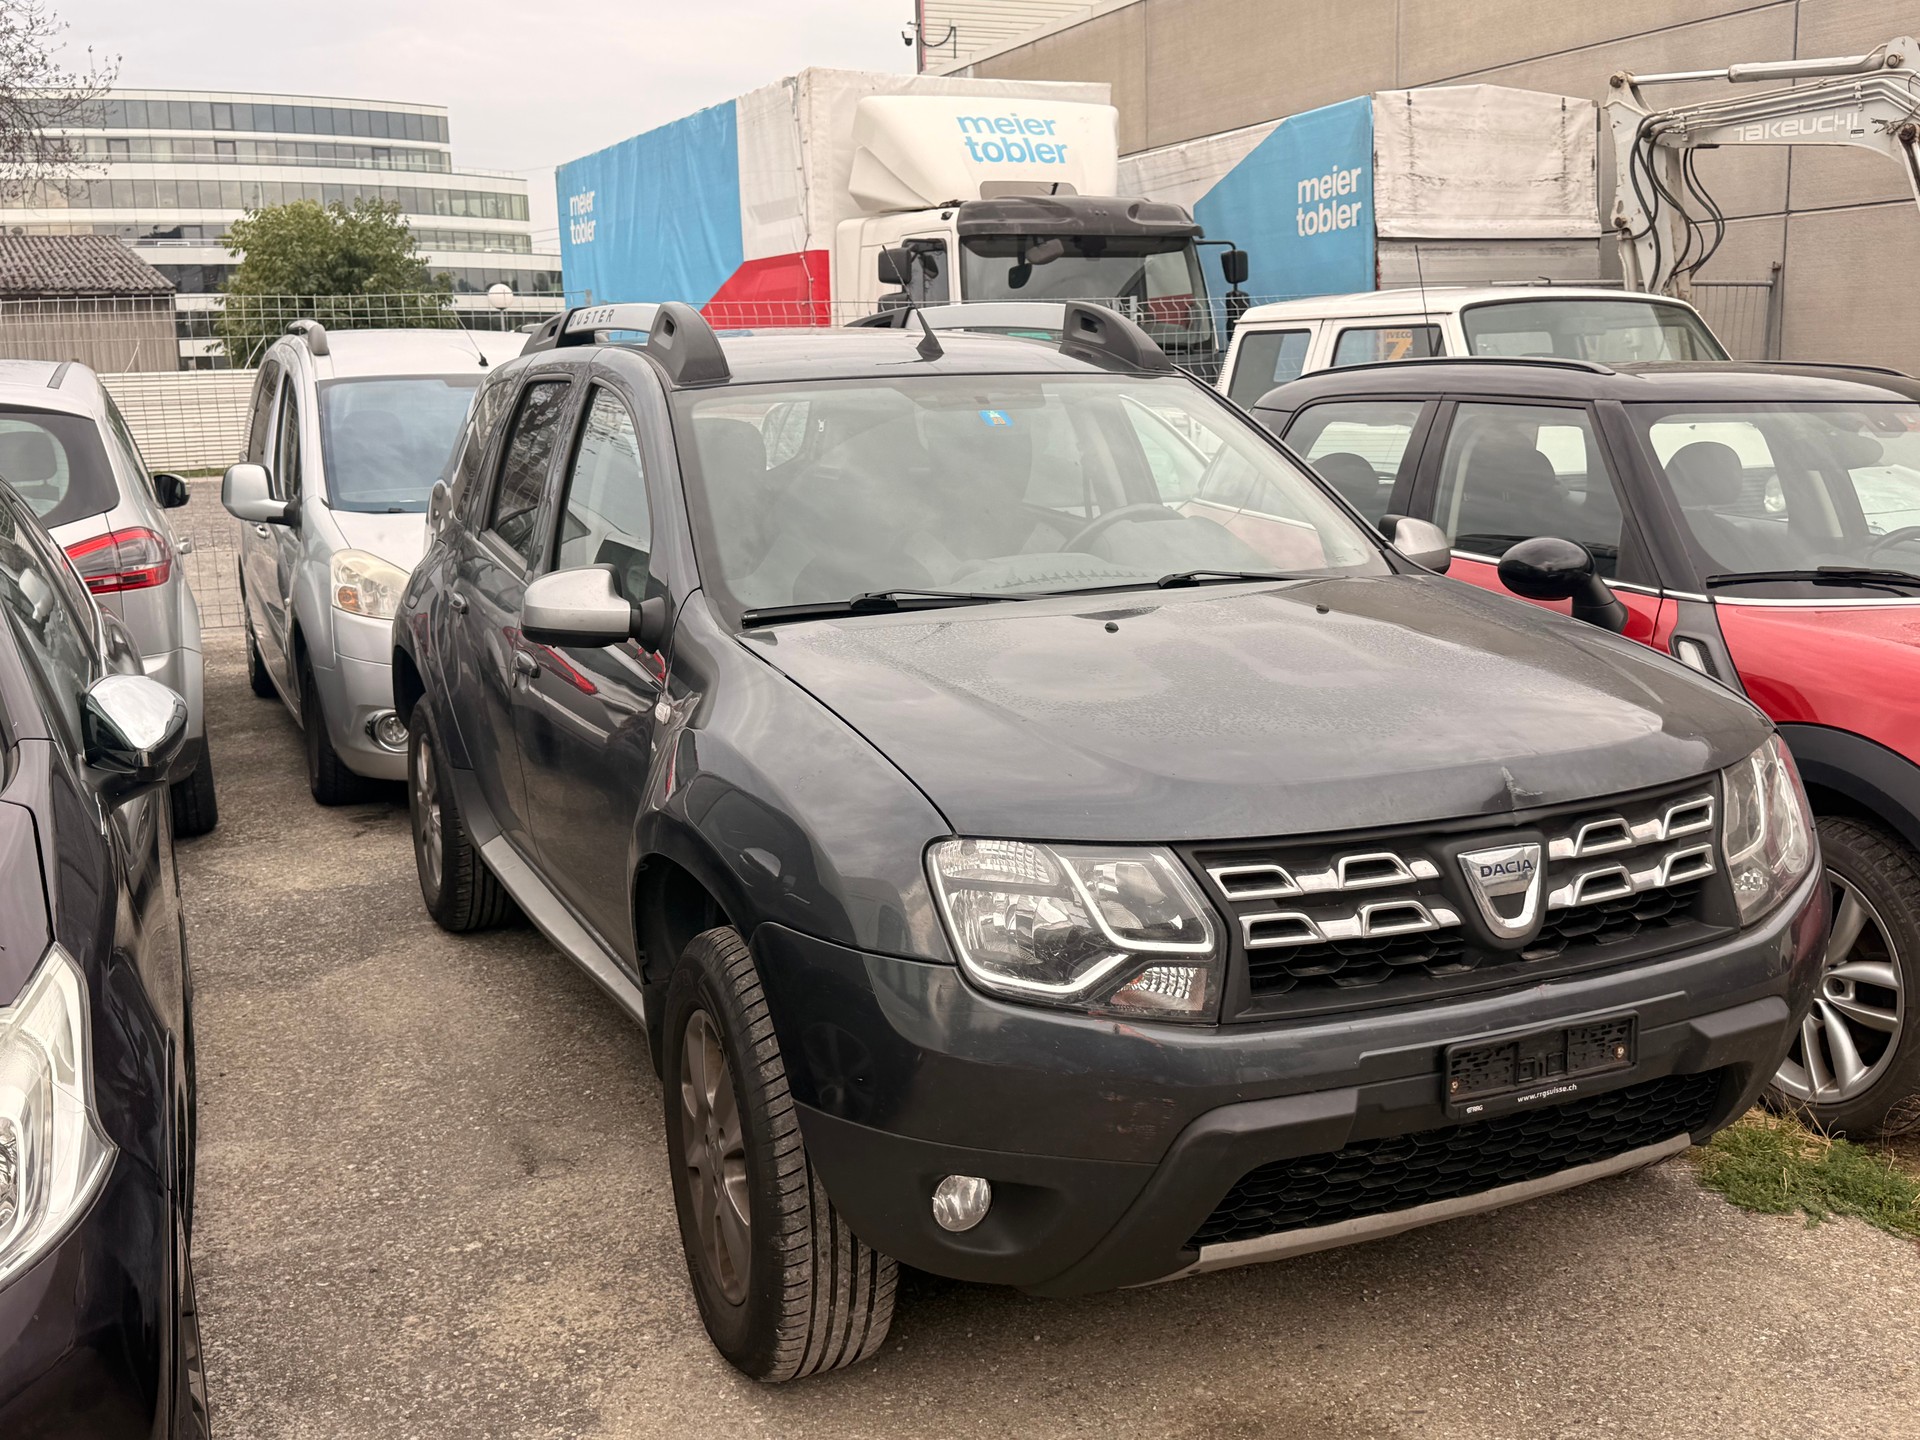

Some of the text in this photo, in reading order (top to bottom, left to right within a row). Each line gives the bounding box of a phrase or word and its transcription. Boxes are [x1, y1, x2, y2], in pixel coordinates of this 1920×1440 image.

[956, 113, 1056, 136] meier
[964, 136, 1067, 164] tobler
[1297, 165, 1362, 204] meier
[570, 186, 595, 216] meier
[570, 216, 596, 245] tobler
[1296, 200, 1362, 237] tobler
[569, 309, 615, 328] DUSTER
[1386, 331, 1413, 339] IVECO
[1480, 860, 1533, 877] DACIA
[1517, 1084, 1578, 1102] www.rrgsuisse.ch
